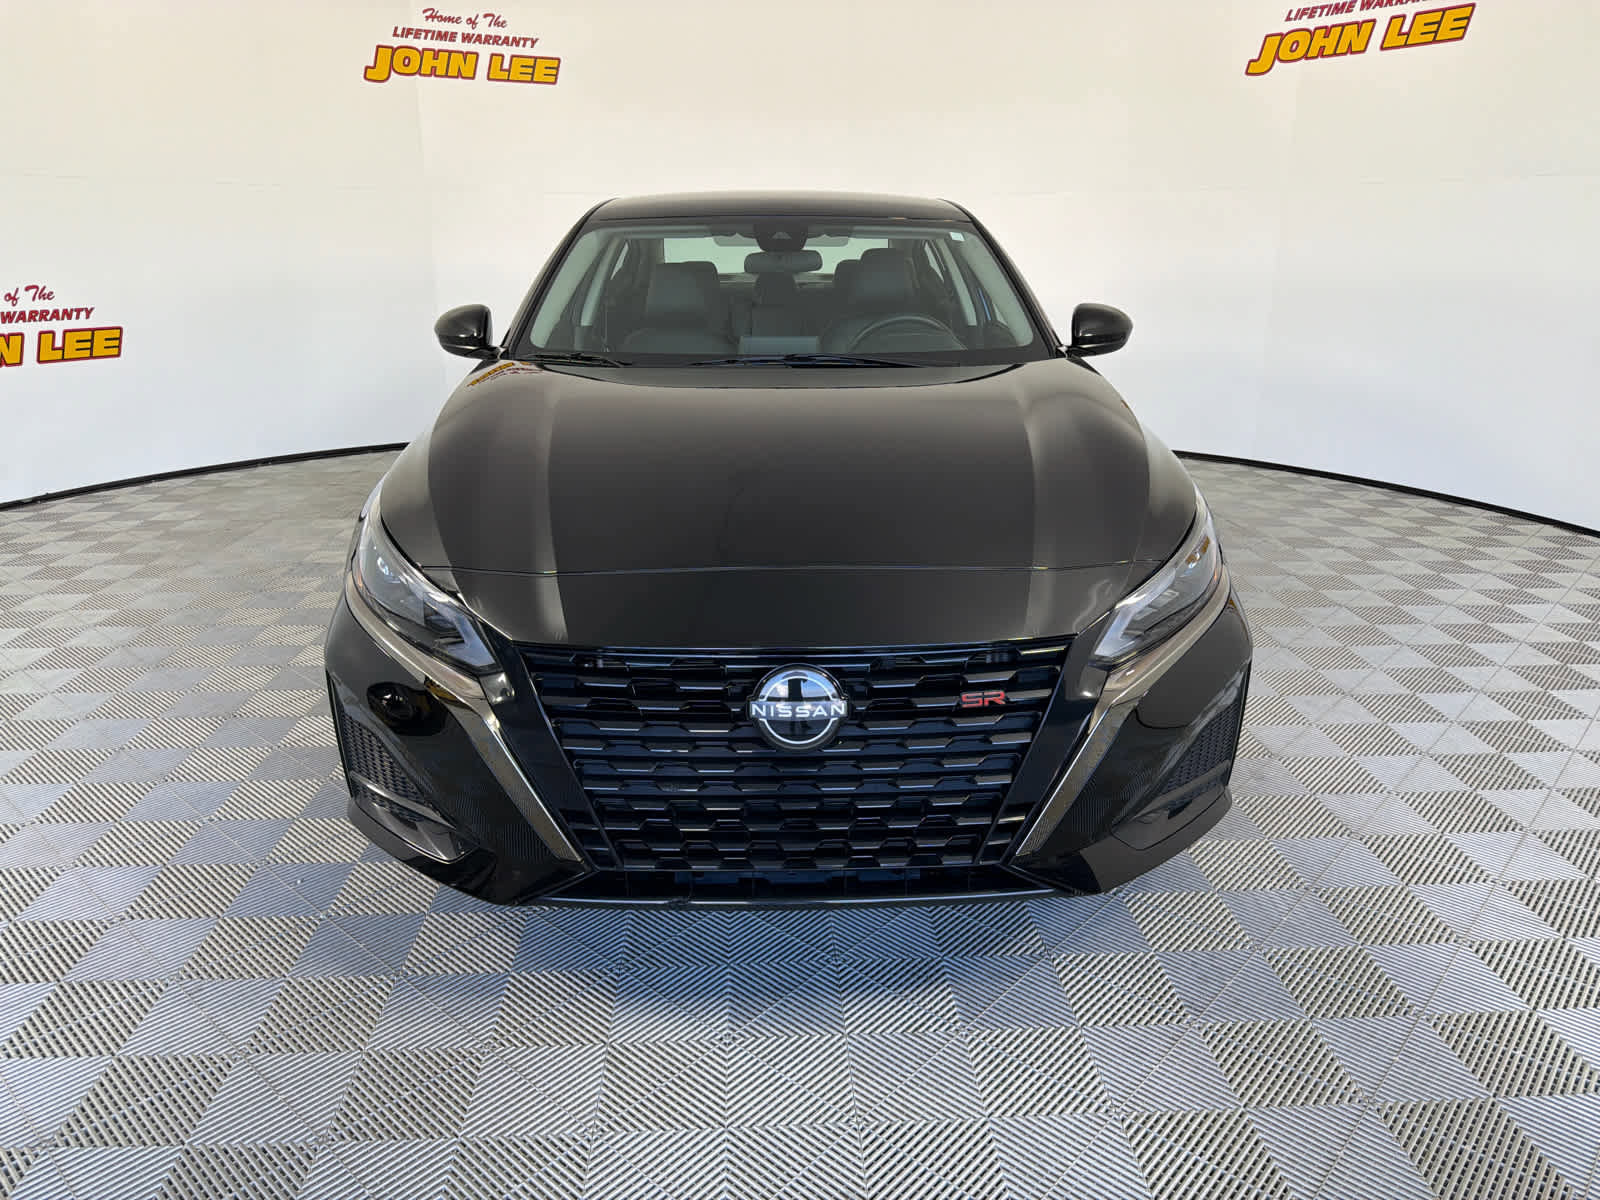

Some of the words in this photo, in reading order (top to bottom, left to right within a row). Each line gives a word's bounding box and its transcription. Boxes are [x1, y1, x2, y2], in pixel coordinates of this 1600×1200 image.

[422, 8, 462, 24] Home
[466, 14, 479, 29] of
[483, 13, 507, 28] The
[1285, 0, 1355, 22] LIFETIME
[392, 26, 458, 43] LIFETIME
[461, 32, 539, 48] WARRANTY
[1245, 19, 1376, 76] JOHN
[1380, 3, 1476, 50] LEE
[364, 45, 479, 83] JOHN
[487, 53, 561, 85] LEE
[4, 287, 20, 307] of
[24, 285, 55, 302] The
[0, 307, 95, 324] WARRANTY
[36, 326, 123, 364] LEE
[751, 703, 845, 717] NISSAN
[961, 690, 1006, 708] SR
